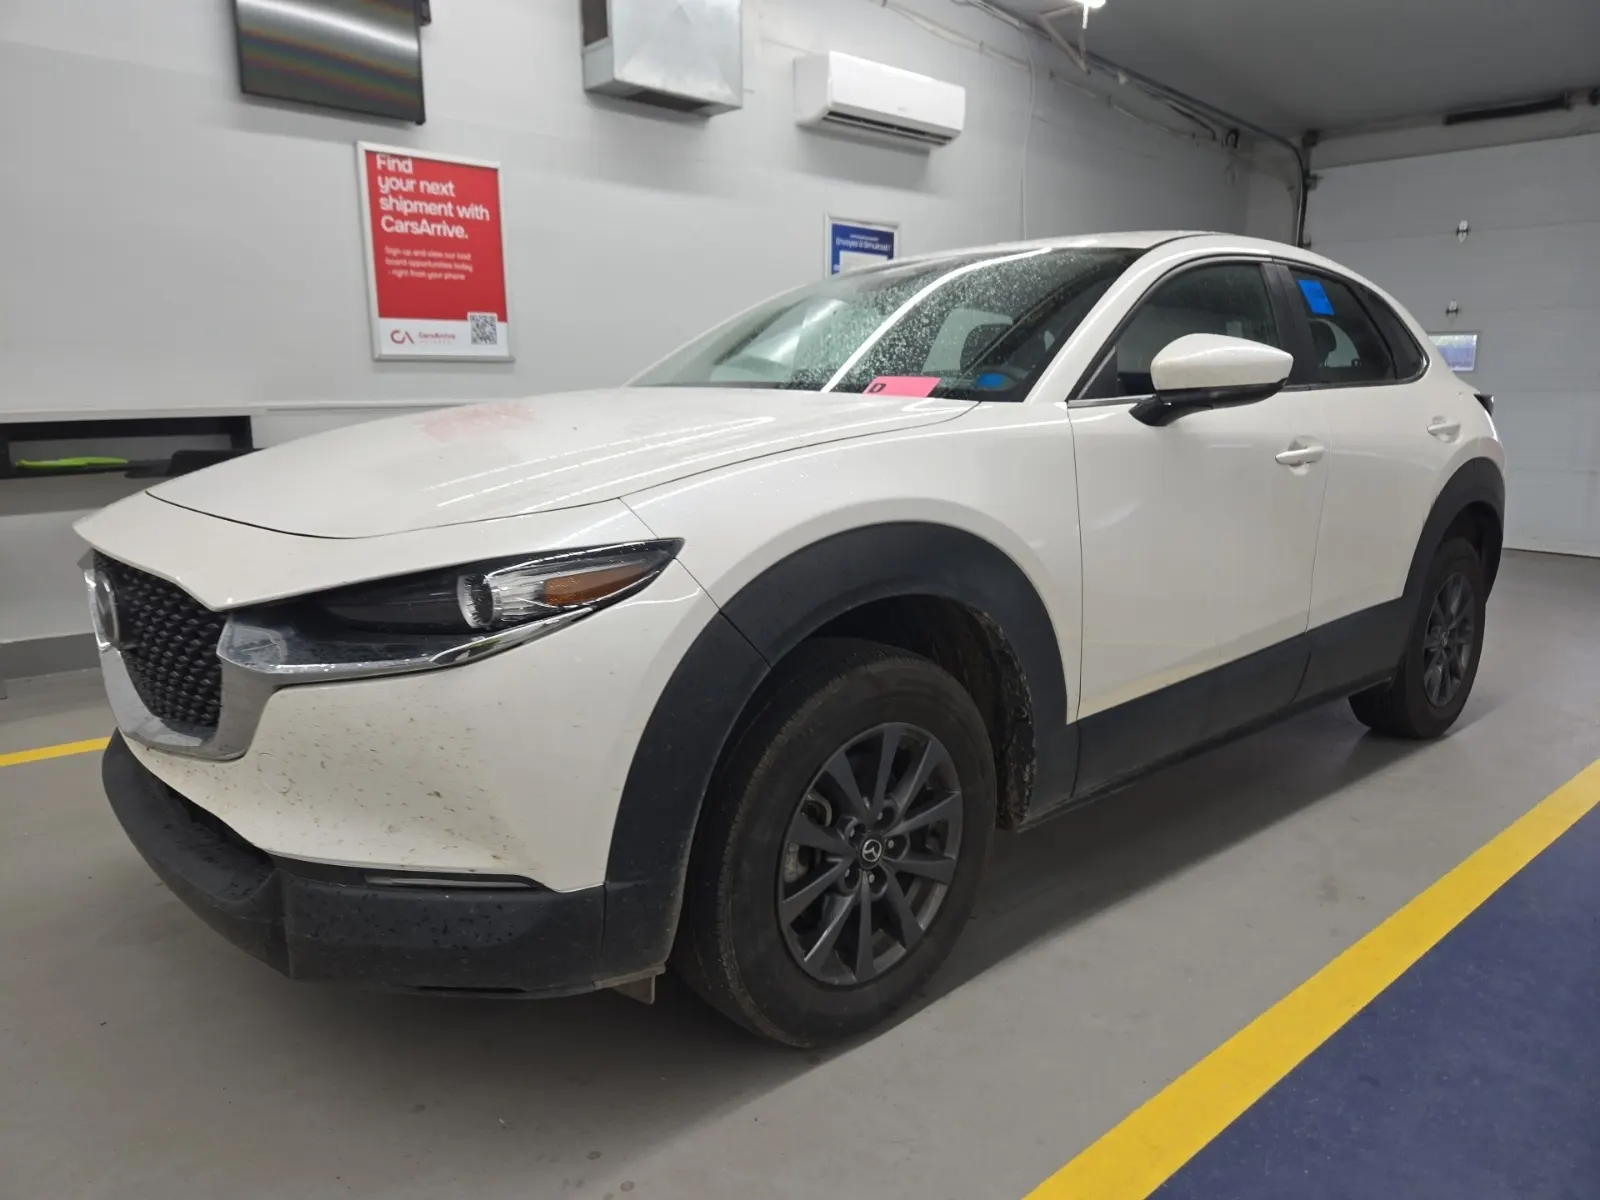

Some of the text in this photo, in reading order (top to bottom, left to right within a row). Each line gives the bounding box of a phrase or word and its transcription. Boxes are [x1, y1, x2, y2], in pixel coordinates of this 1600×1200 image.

[376, 154, 413, 174] Find
[377, 175, 456, 197] your next
[379, 194, 490, 221] shipment with
[381, 215, 469, 239] CarsArrive.
[384, 245, 401, 257] Sign
[402, 248, 411, 257] up
[412, 248, 426, 257] and
[391, 268, 408, 278] right
[409, 268, 426, 277] from
[427, 271, 443, 280] your
[444, 271, 466, 280] phone
[453, 262, 473, 273] today
